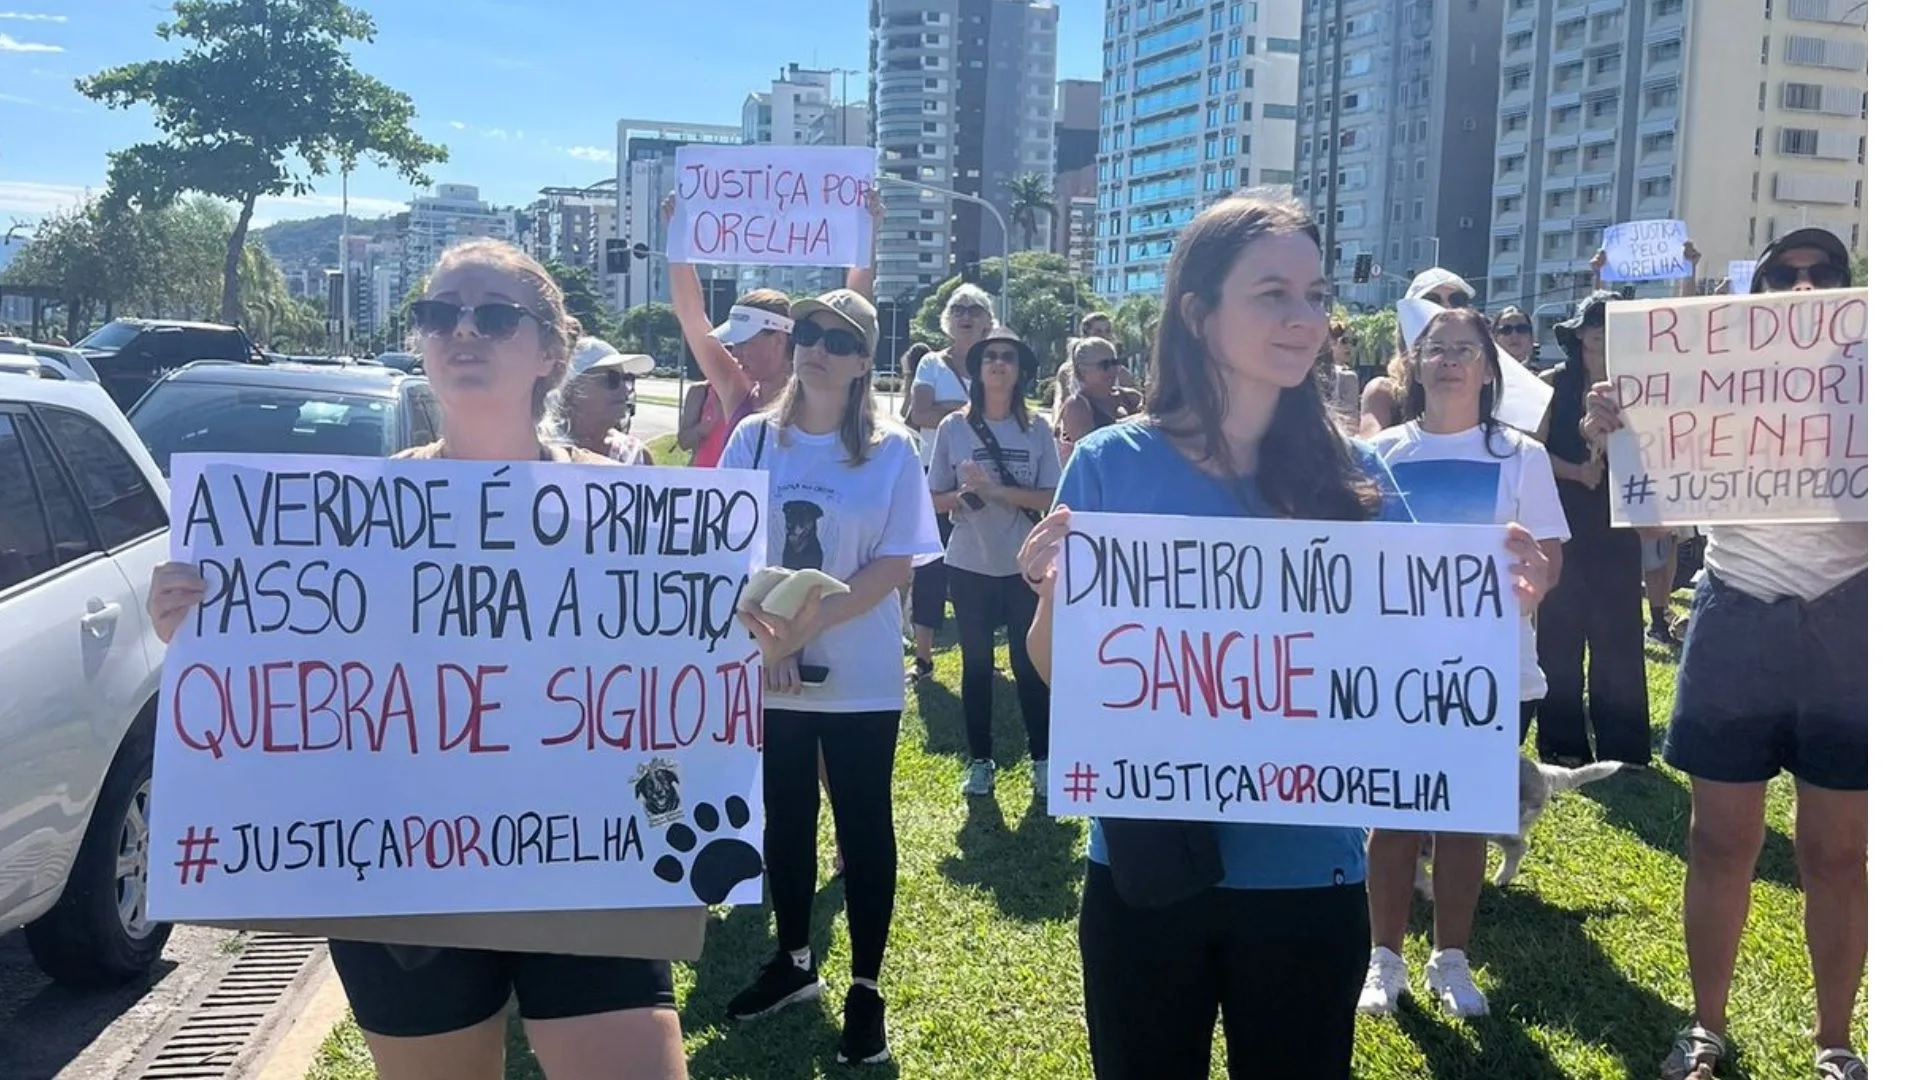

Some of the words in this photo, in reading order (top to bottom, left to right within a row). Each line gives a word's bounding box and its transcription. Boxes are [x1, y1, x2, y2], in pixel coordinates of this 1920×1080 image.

[679, 164, 809, 211] JUSTIÇA
[694, 211, 831, 256] ORELHA
[1631, 241, 1668, 258] PELO
[1617, 257, 1685, 278] ORELHA
[1648, 299, 1868, 358] REDUÇ
[1617, 372, 1671, 410] DA
[1699, 358, 1865, 405] MAIORI
[1668, 410, 1868, 461] PENAL
[183, 472, 223, 547] A
[234, 470, 456, 549] VERDADE
[480, 465, 516, 550] É
[533, 484, 570, 549] O
[585, 481, 759, 557] PRIMEIRO
[196, 558, 367, 638] PASSO
[413, 563, 532, 641] PARA
[548, 568, 597, 637] A
[1064, 531, 1263, 610] DINHEIRO
[1281, 536, 1352, 614] NÃO
[1379, 551, 1503, 618] LIMPA
[173, 660, 419, 760] QUEBRA
[438, 663, 511, 755] DE
[541, 666, 706, 752] SIGILO
[712, 650, 763, 752] JÁ!
[1099, 623, 1318, 720] SANGUE
[1330, 666, 1379, 720] NO
[1396, 656, 1504, 732] CHÃO.
